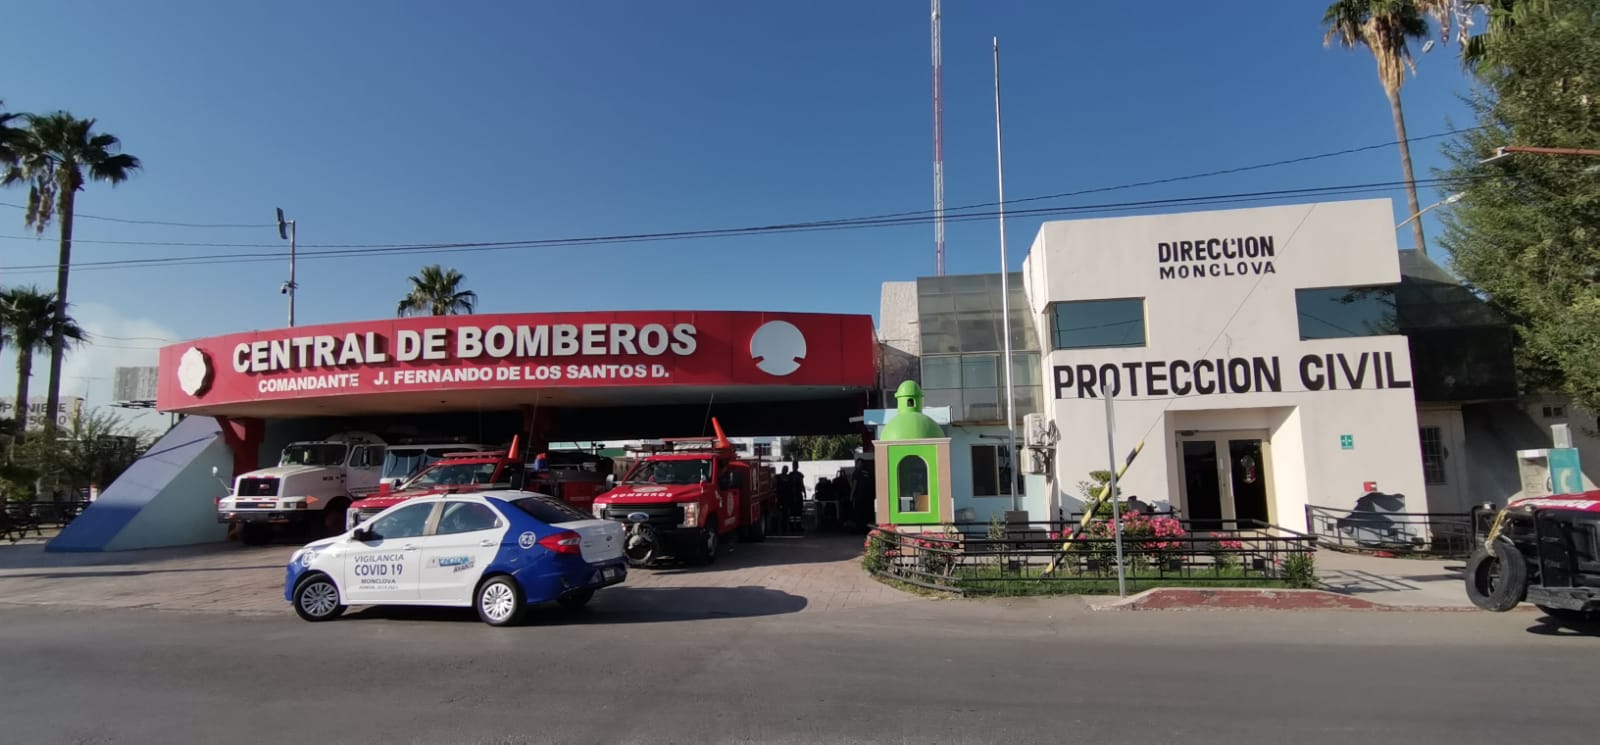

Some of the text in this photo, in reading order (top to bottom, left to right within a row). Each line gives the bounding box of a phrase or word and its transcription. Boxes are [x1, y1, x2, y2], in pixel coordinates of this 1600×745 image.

[1158, 236, 1275, 263] DIRECCION
[1159, 261, 1276, 280] MONCLOVA
[232, 323, 698, 374] CENTRAL DE BOMBEROS
[258, 363, 670, 393] COMANDANTE J. FERNANDO DE LOS SANTOS D.
[1053, 351, 1412, 399] PROTECCION CIVIL
[354, 554, 404, 563] VIGILANCIA
[354, 563, 403, 577] COVID 19
